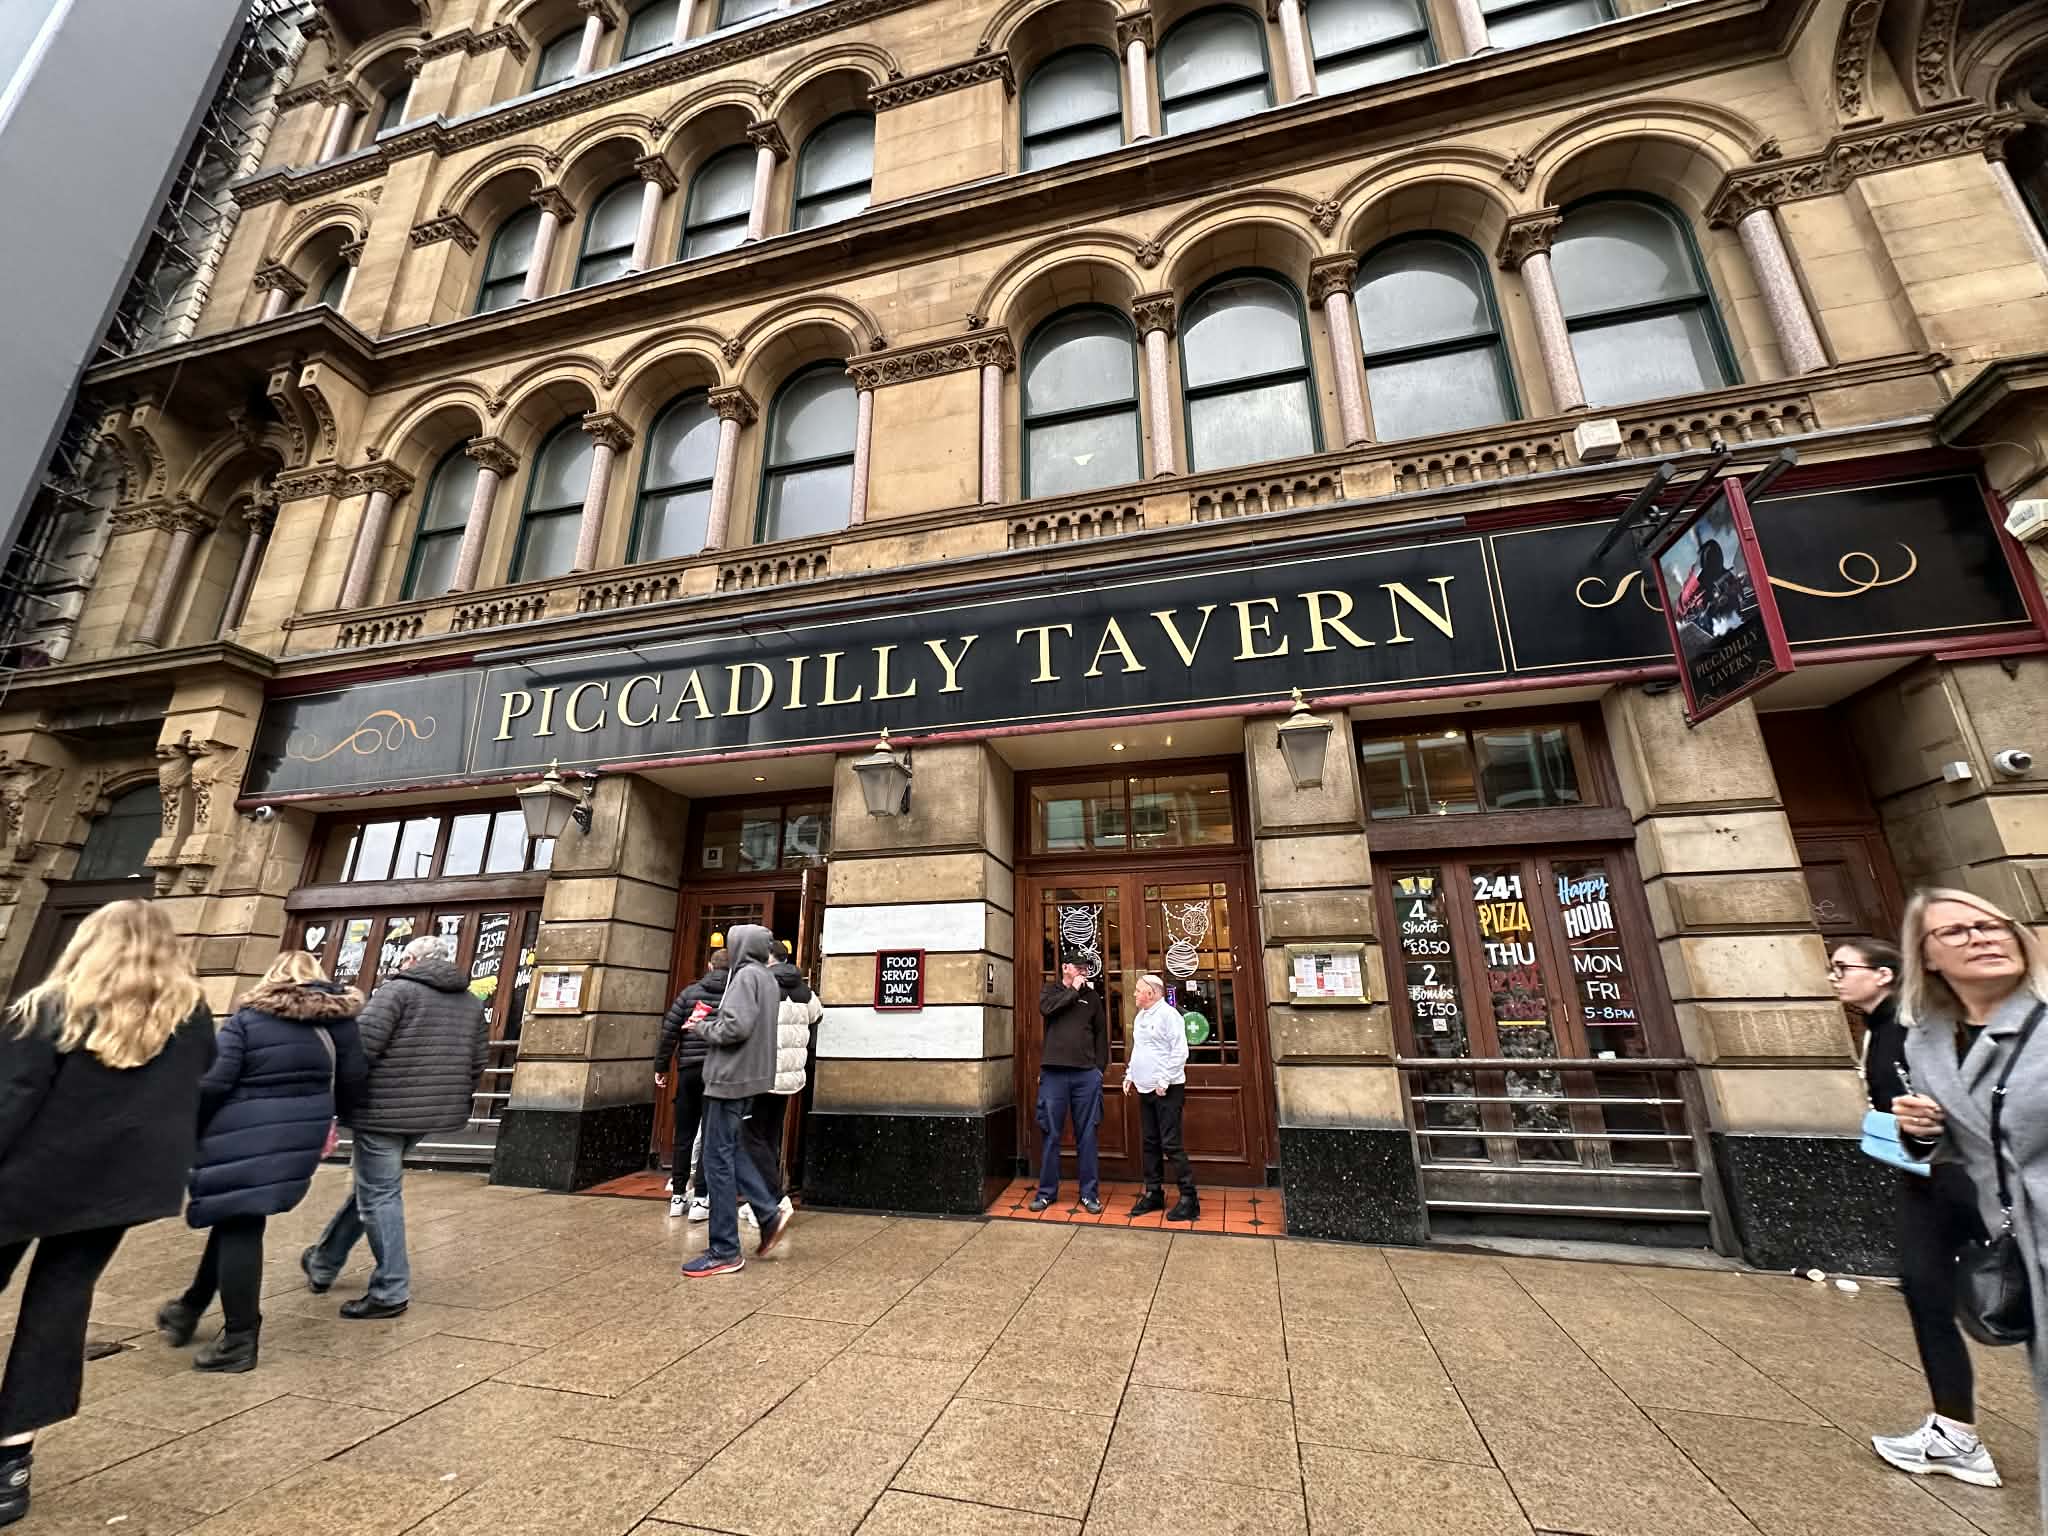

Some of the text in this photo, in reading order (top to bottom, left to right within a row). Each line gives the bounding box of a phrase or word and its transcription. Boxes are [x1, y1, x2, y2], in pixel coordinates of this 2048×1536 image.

[492, 575, 1455, 741] PICCADILLY TAVERN
[1695, 631, 1758, 679] PICCADILLY
[1710, 653, 1753, 688] TAVERN
[1473, 875, 1523, 900] 2-4-1
[1557, 876, 1609, 905] Happy
[1409, 899, 1427, 920] 4
[1478, 901, 1532, 937] PIZZA
[1564, 901, 1614, 938] HOUR
[1402, 919, 1444, 935] Shots
[476, 930, 506, 954] FISH
[1410, 938, 1450, 955] £8.50
[886, 957, 917, 969] FOOD
[1485, 942, 1536, 966] THU
[1573, 954, 1623, 973] MON
[471, 958, 501, 978] CHIPS
[881, 969, 919, 981] SERVED
[1423, 964, 1438, 986] 2
[885, 983, 913, 994] DAILY
[1412, 984, 1454, 1001] Bombs
[1586, 981, 1621, 1000] FRI
[1417, 1002, 1458, 1017] £7.50
[1584, 1007, 1635, 1019] 5-8PM
